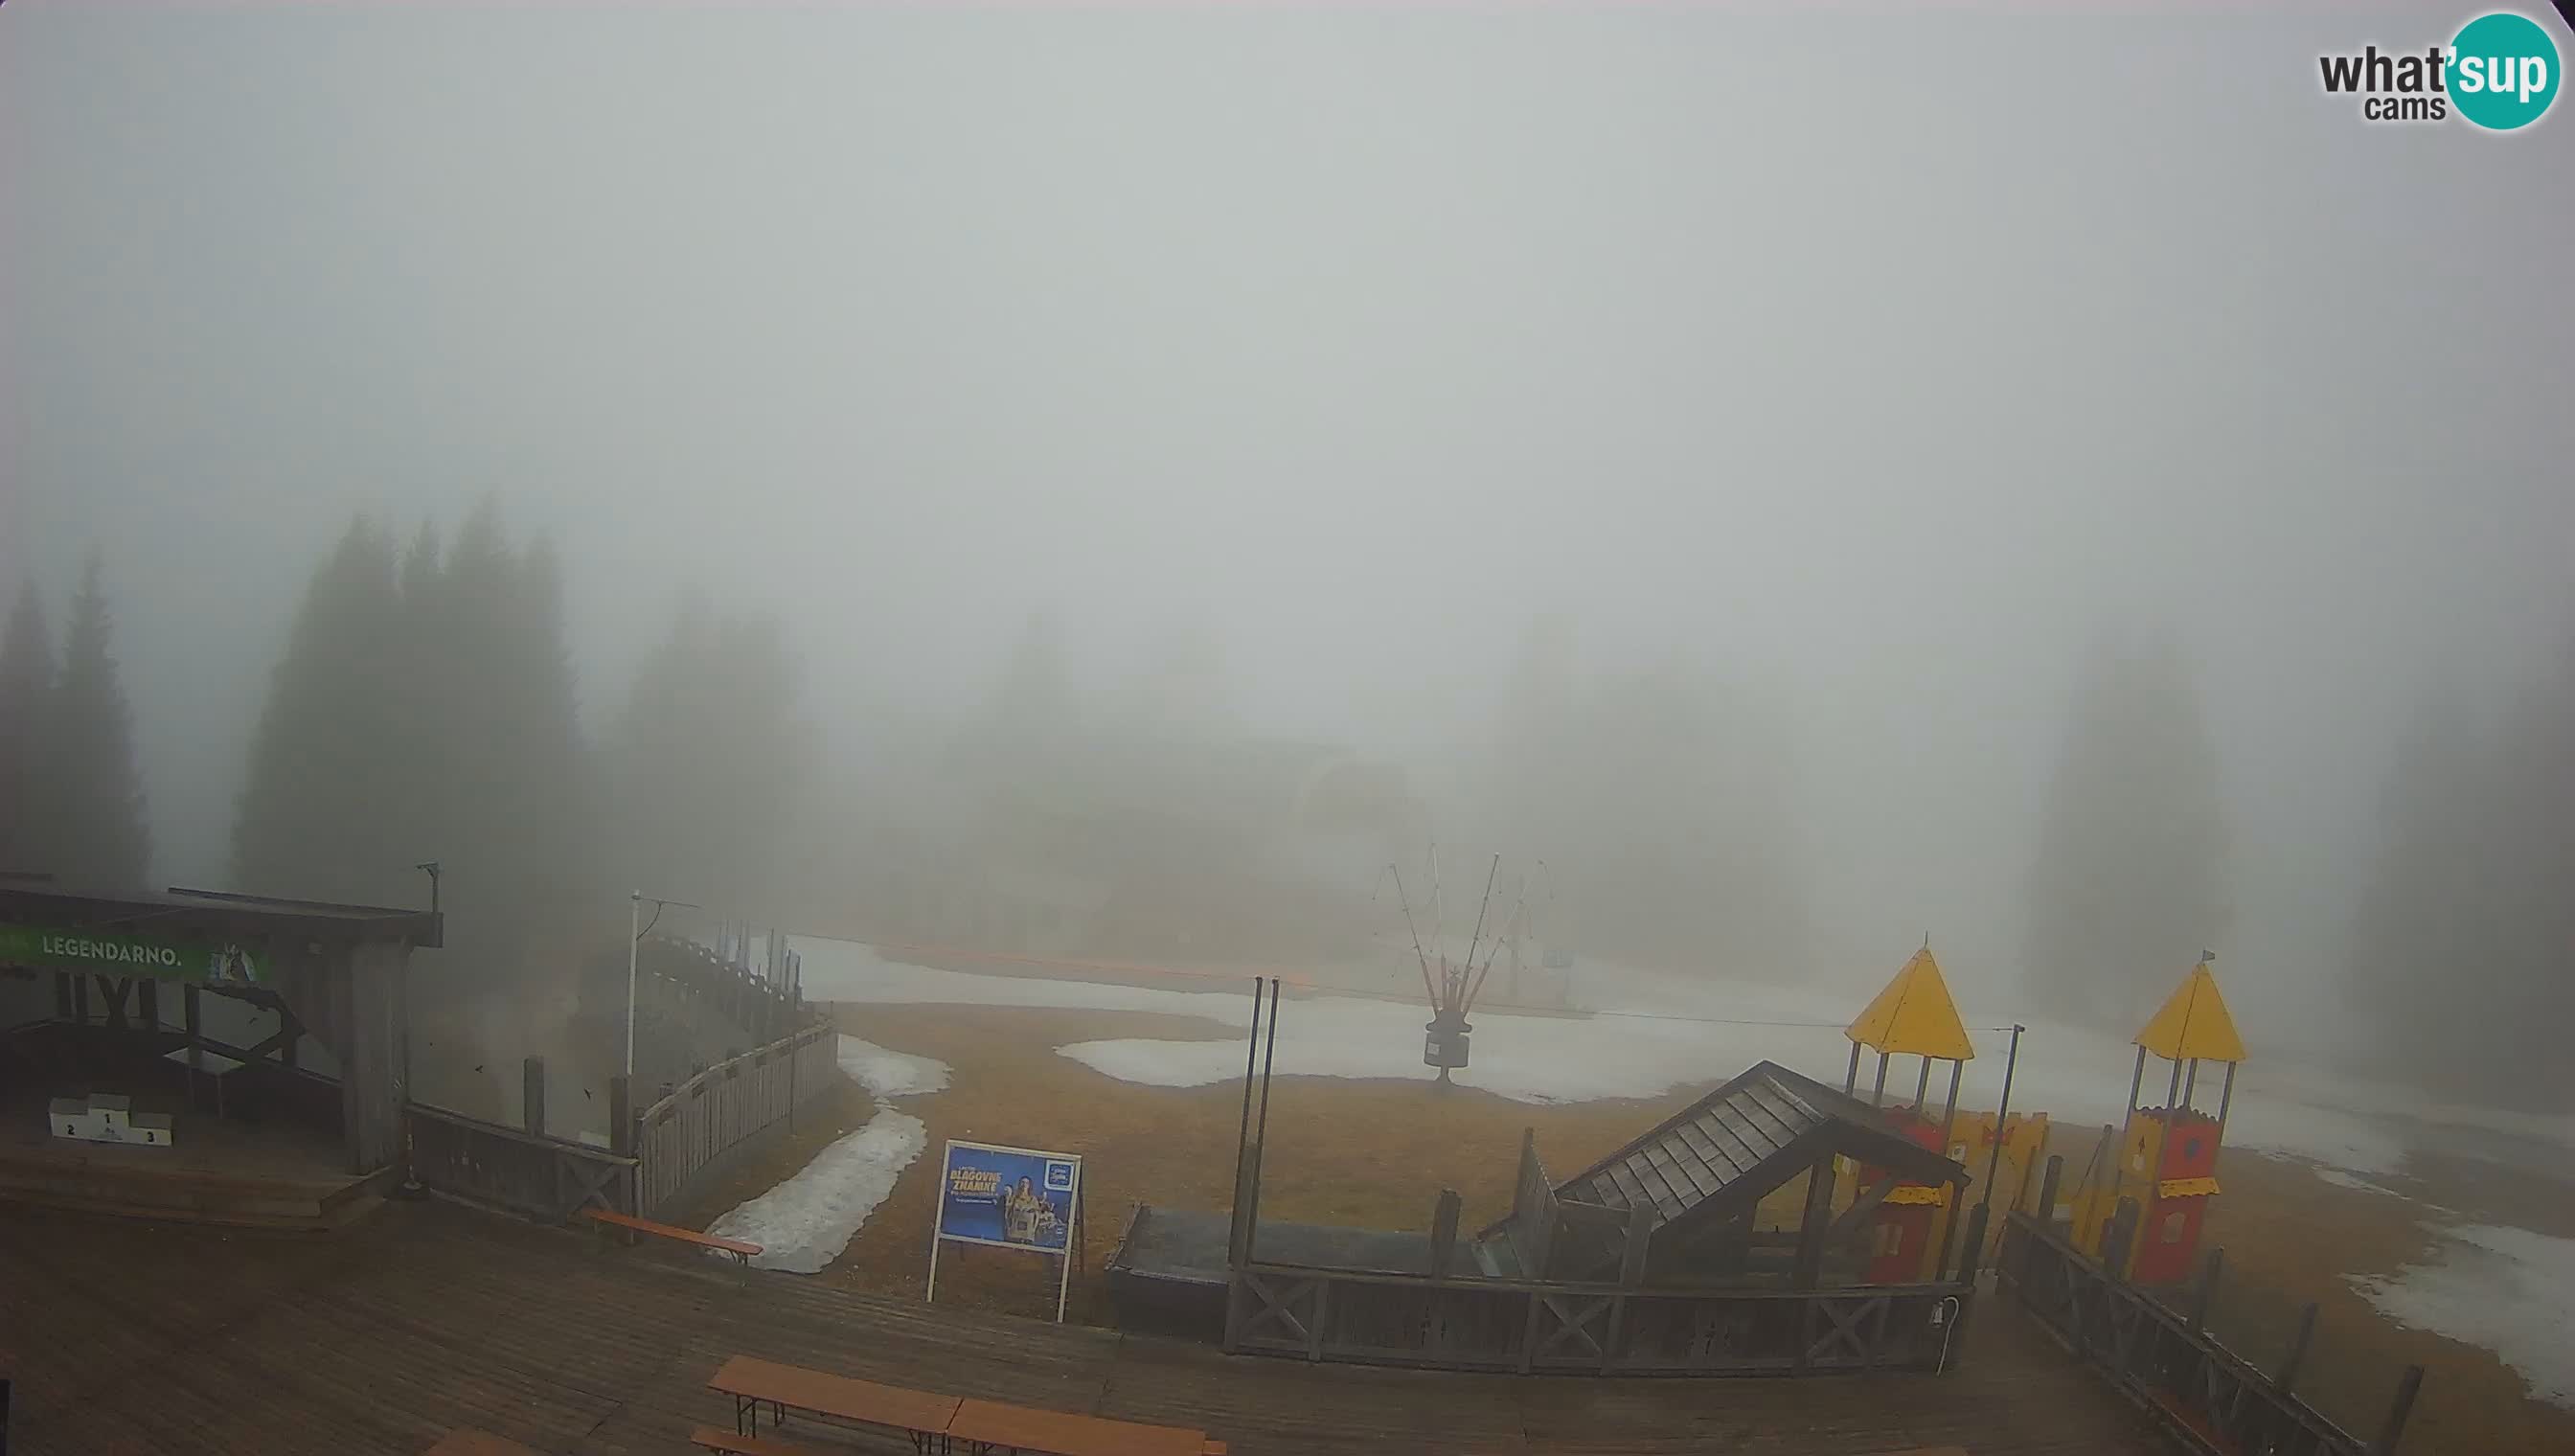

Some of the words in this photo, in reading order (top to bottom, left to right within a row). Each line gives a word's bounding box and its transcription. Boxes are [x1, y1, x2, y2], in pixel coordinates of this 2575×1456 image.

[42, 936, 182, 967] LEGENDARNO.
[104, 1113, 111, 1124] 1
[67, 1125, 75, 1135] 2
[148, 1131, 154, 1142] 3
[950, 1170, 1002, 1182] BLAGOVNE
[953, 1180, 997, 1192] ZNAMKE
